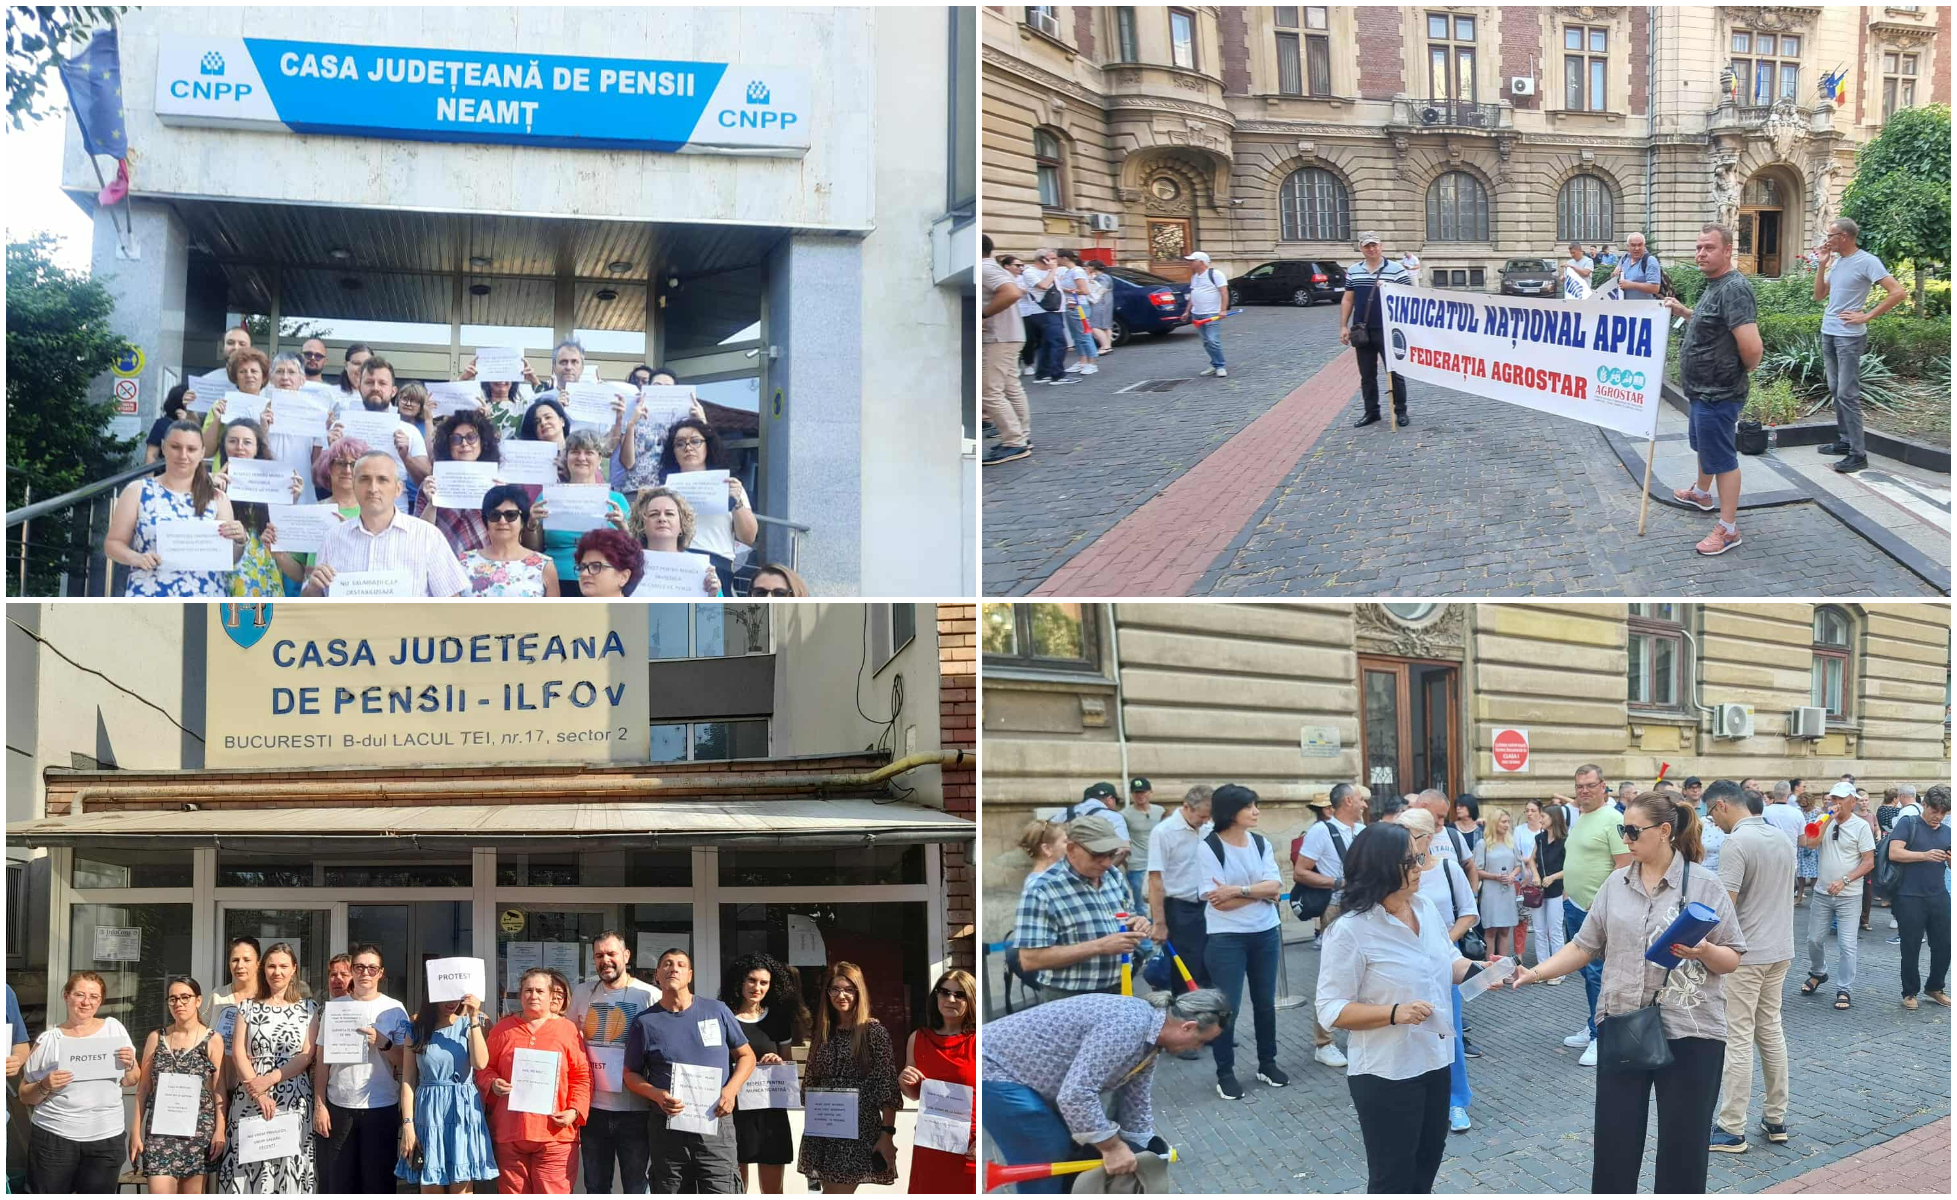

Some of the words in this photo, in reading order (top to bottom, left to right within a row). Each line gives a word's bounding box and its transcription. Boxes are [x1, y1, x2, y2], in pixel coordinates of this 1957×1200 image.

[279, 52, 359, 80] CASA
[367, 57, 544, 93] JUDEȚEANĂ
[552, 67, 591, 92] DE
[600, 69, 695, 97] PENSII
[170, 79, 253, 102] CNPP
[436, 97, 539, 134] NEAMȚ
[717, 109, 798, 130] CNPP
[1386, 294, 1479, 334] SINDICATUL
[1483, 305, 1587, 350] NAȚIONAL
[1592, 313, 1653, 358] APIA
[1409, 345, 1487, 382] FEDERAȚIA
[1491, 360, 1588, 400] AGROSTAR
[1594, 384, 1645, 405] AGROSTAR
[272, 638, 376, 670] CASA
[272, 687, 320, 715] DE
[333, 683, 466, 715] PENSII
[503, 680, 626, 711] ILFOV
[224, 734, 333, 749] BUCURESTI
[343, 733, 387, 747] B-dul
[393, 732, 455, 747] LACUL
[460, 731, 495, 746] TEI,
[556, 729, 612, 743] sector
[617, 726, 629, 741] 2
[438, 972, 472, 981] PROTEST
[69, 1053, 107, 1063] PROTEST
[591, 1062, 606, 1070] TEST
